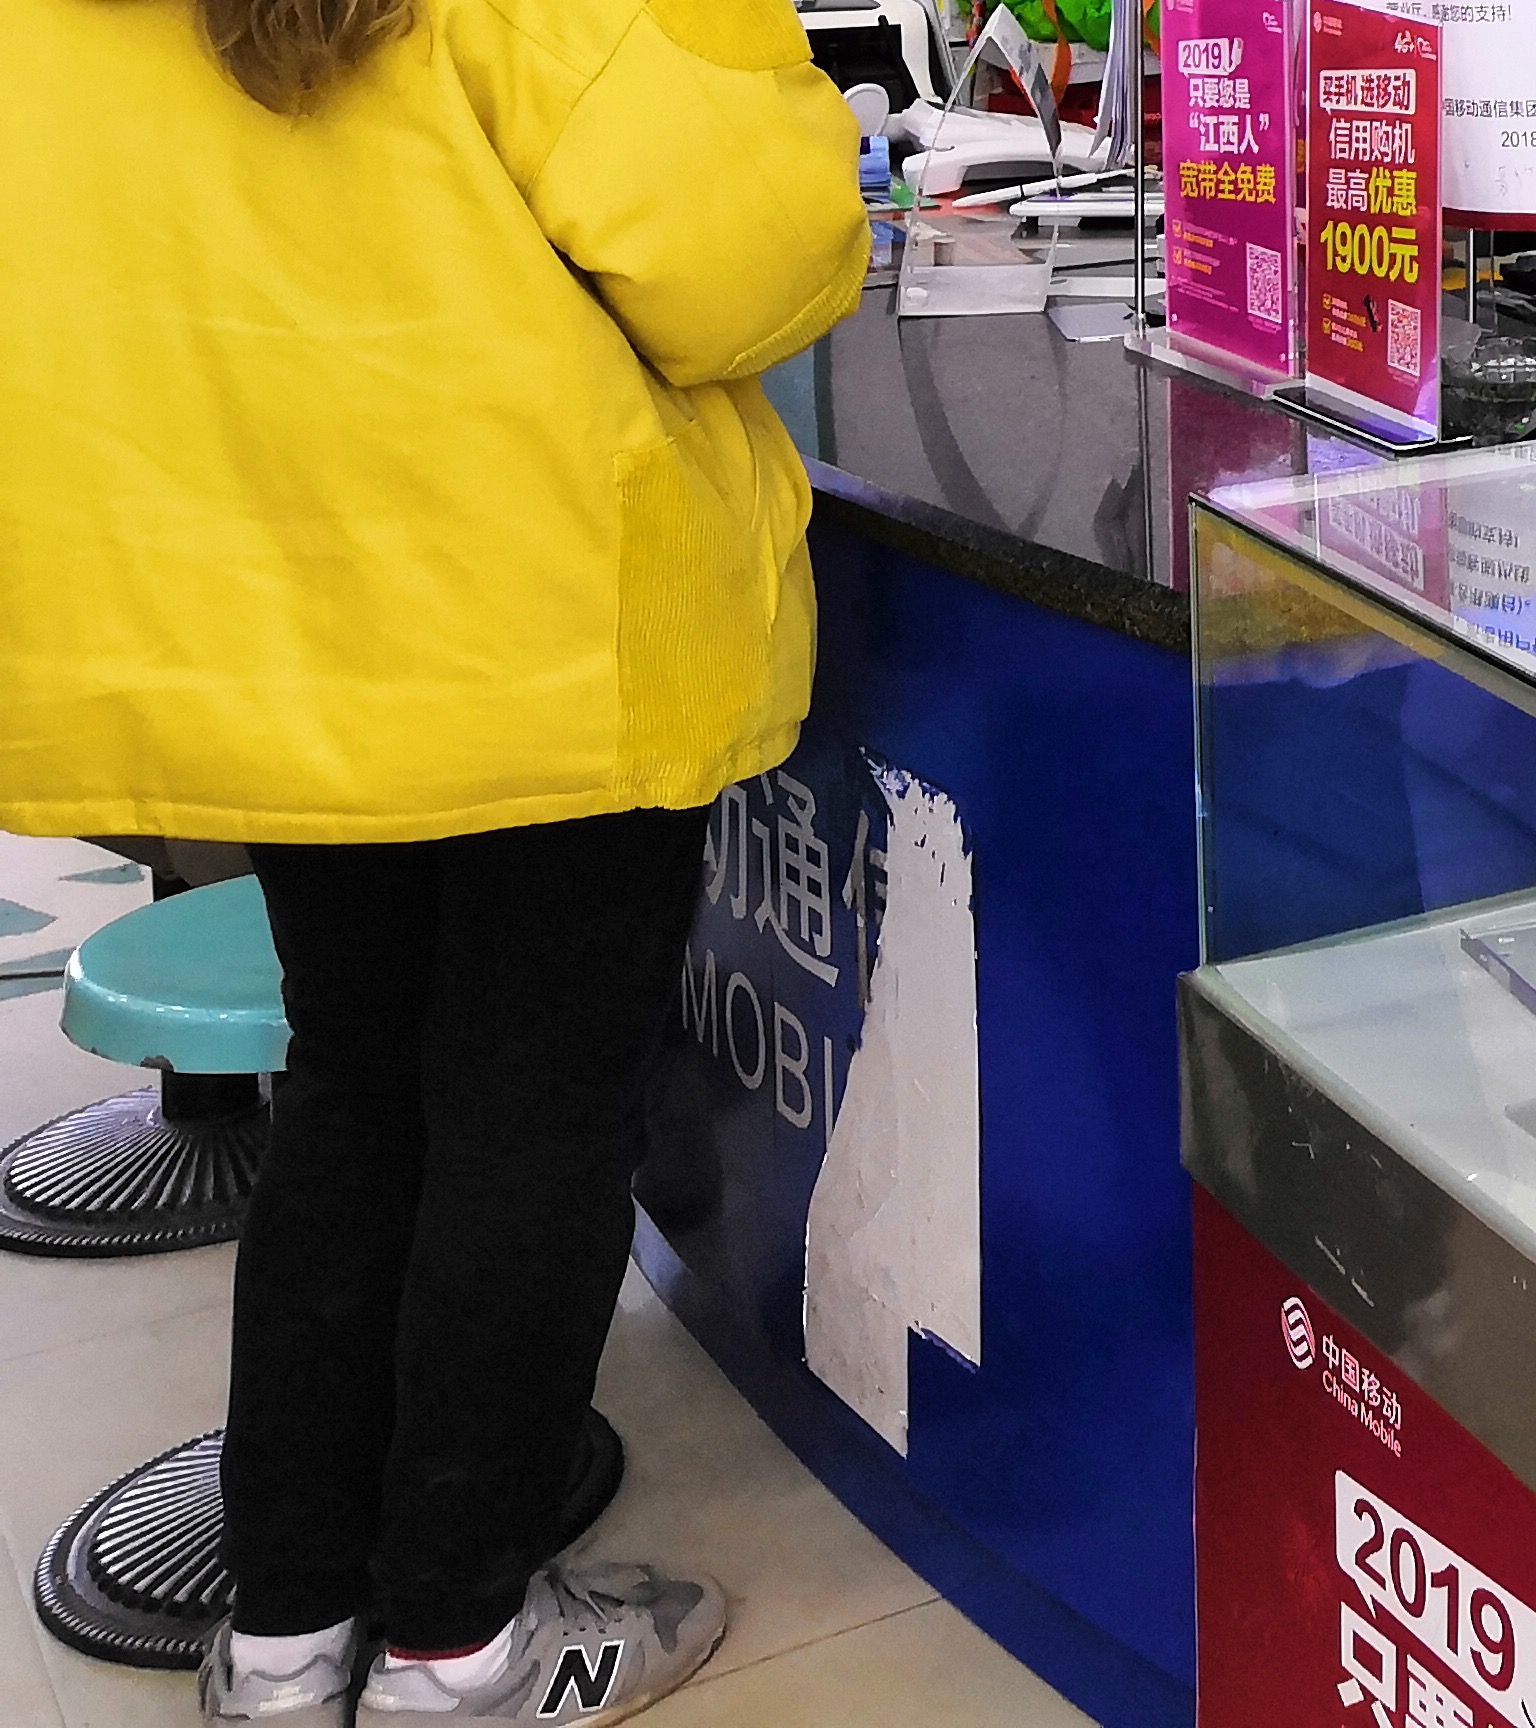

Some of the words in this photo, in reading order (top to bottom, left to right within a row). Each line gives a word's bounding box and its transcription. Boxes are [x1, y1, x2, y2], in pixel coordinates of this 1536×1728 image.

[1182, 41, 1223, 71] 2019
[1189, 78, 1251, 110] 只要您是
[1329, 118, 1415, 165] 信用购机
[1180, 160, 1276, 205] 宽带全免费
[1326, 166, 1417, 216] 最高优惠
[1320, 220, 1419, 284] 1900元
[1322, 1334, 1402, 1430] 中国移动
[1322, 1370, 1359, 1418] China
[1360, 1402, 1402, 1458] Mobile
[1353, 1497, 1517, 1694] 2019
[537, 1640, 624, 1719] N
